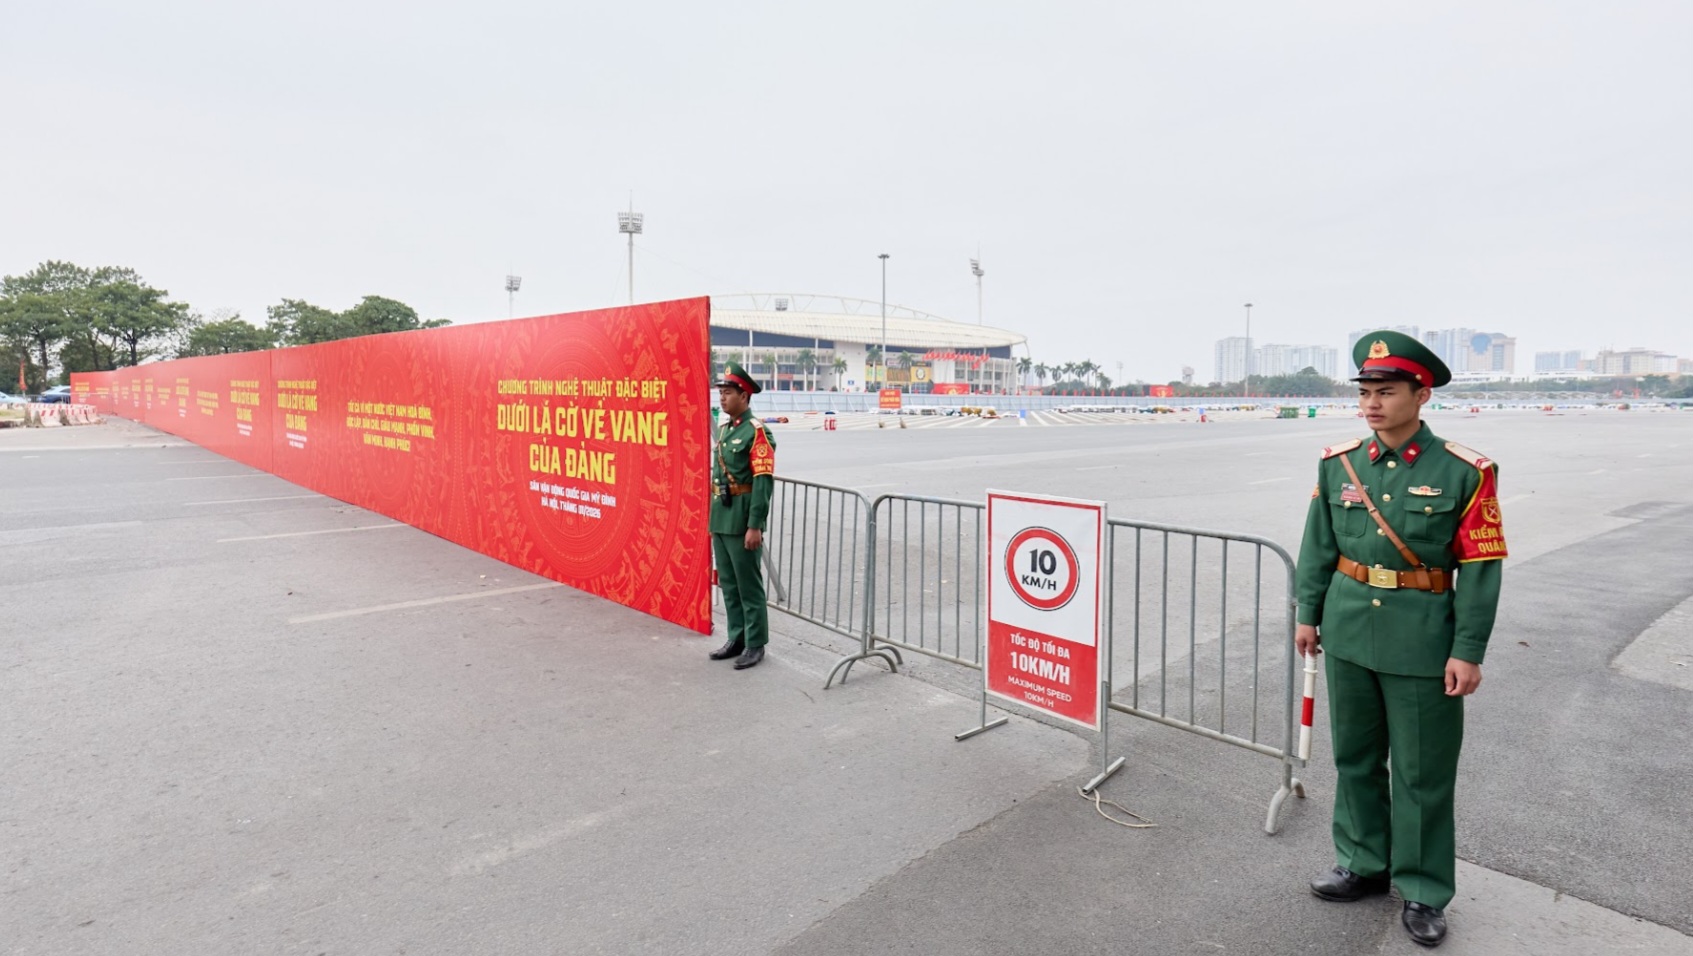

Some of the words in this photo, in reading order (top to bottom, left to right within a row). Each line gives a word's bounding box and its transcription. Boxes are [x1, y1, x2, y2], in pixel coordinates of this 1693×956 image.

[498, 379, 527, 394] CHƯƠNG
[529, 377, 553, 395] TRÌNH
[555, 377, 579, 400] NGHỆ
[581, 377, 613, 401] THUẬT
[615, 377, 638, 402] ĐẶC
[641, 376, 668, 403] BIỆT
[497, 399, 530, 433] DƯỚI
[533, 399, 552, 435] LÁ
[555, 401, 579, 438] CỜ
[581, 400, 606, 440] VẺ
[610, 409, 668, 447] VANG
[529, 437, 562, 476] CỦA
[565, 441, 616, 485] ĐẢNG
[560, 500, 577, 514] THÁNG
[580, 490, 590, 502] GIA
[1469, 524, 1499, 540] KIỂM
[1029, 548, 1057, 576] 10
[1021, 574, 1057, 591] KM/H
[1010, 632, 1027, 647] TỐC
[1028, 637, 1040, 654] ĐỘ
[1041, 638, 1056, 656] TỐI
[1057, 645, 1070, 660] ĐA
[1010, 651, 1070, 686] 10KM/H
[1008, 675, 1046, 694] MAXIMUM
[1046, 687, 1072, 703] SPEED
[1023, 690, 1054, 708] 10KM/H
